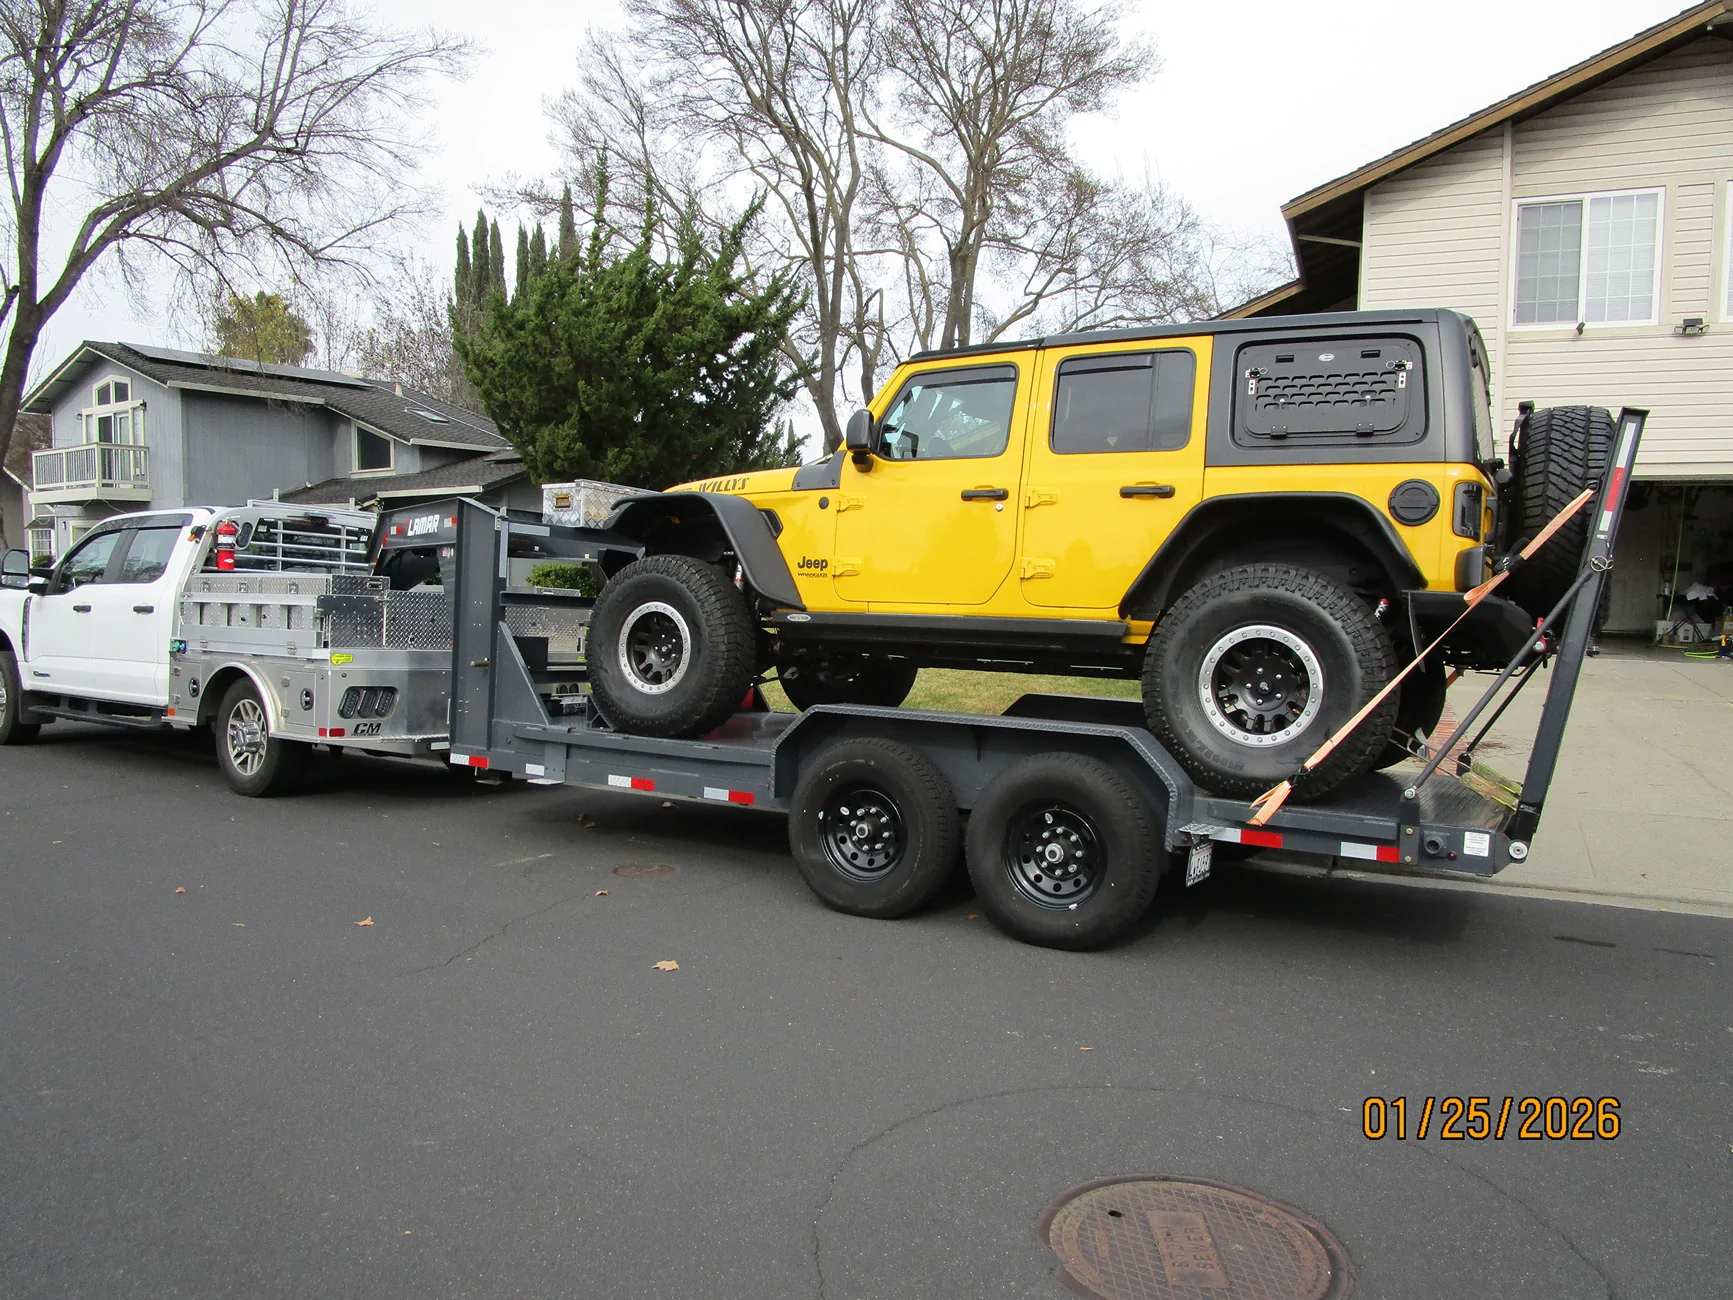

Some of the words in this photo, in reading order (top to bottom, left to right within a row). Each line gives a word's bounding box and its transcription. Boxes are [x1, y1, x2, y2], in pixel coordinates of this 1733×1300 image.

[699, 477, 750, 492] WILLYS
[407, 514, 440, 536] LAMAR
[797, 556, 828, 571] Jeep
[1184, 1228, 1215, 1269] SEWER
